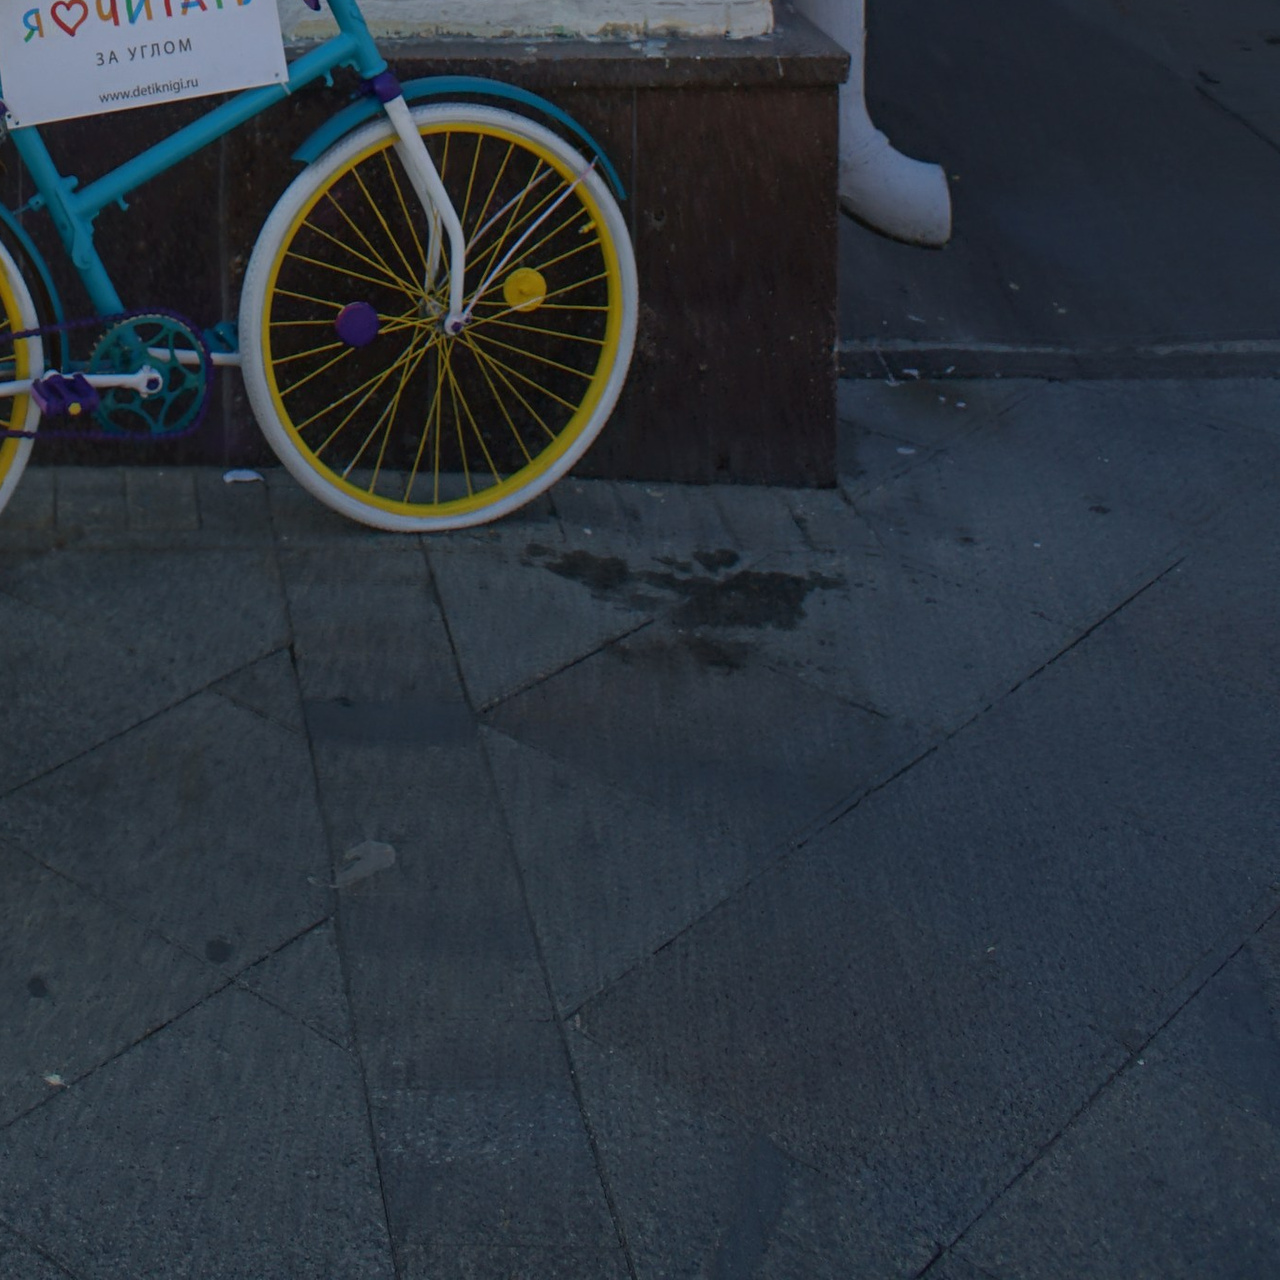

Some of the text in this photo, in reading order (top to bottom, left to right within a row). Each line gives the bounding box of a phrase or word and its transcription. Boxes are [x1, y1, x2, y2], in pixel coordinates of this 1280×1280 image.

[22, 8, 45, 42] Я
[96, 38, 193, 66] ЗА УГЛОМ
[98, 77, 199, 104] www.detiknigi.ru
